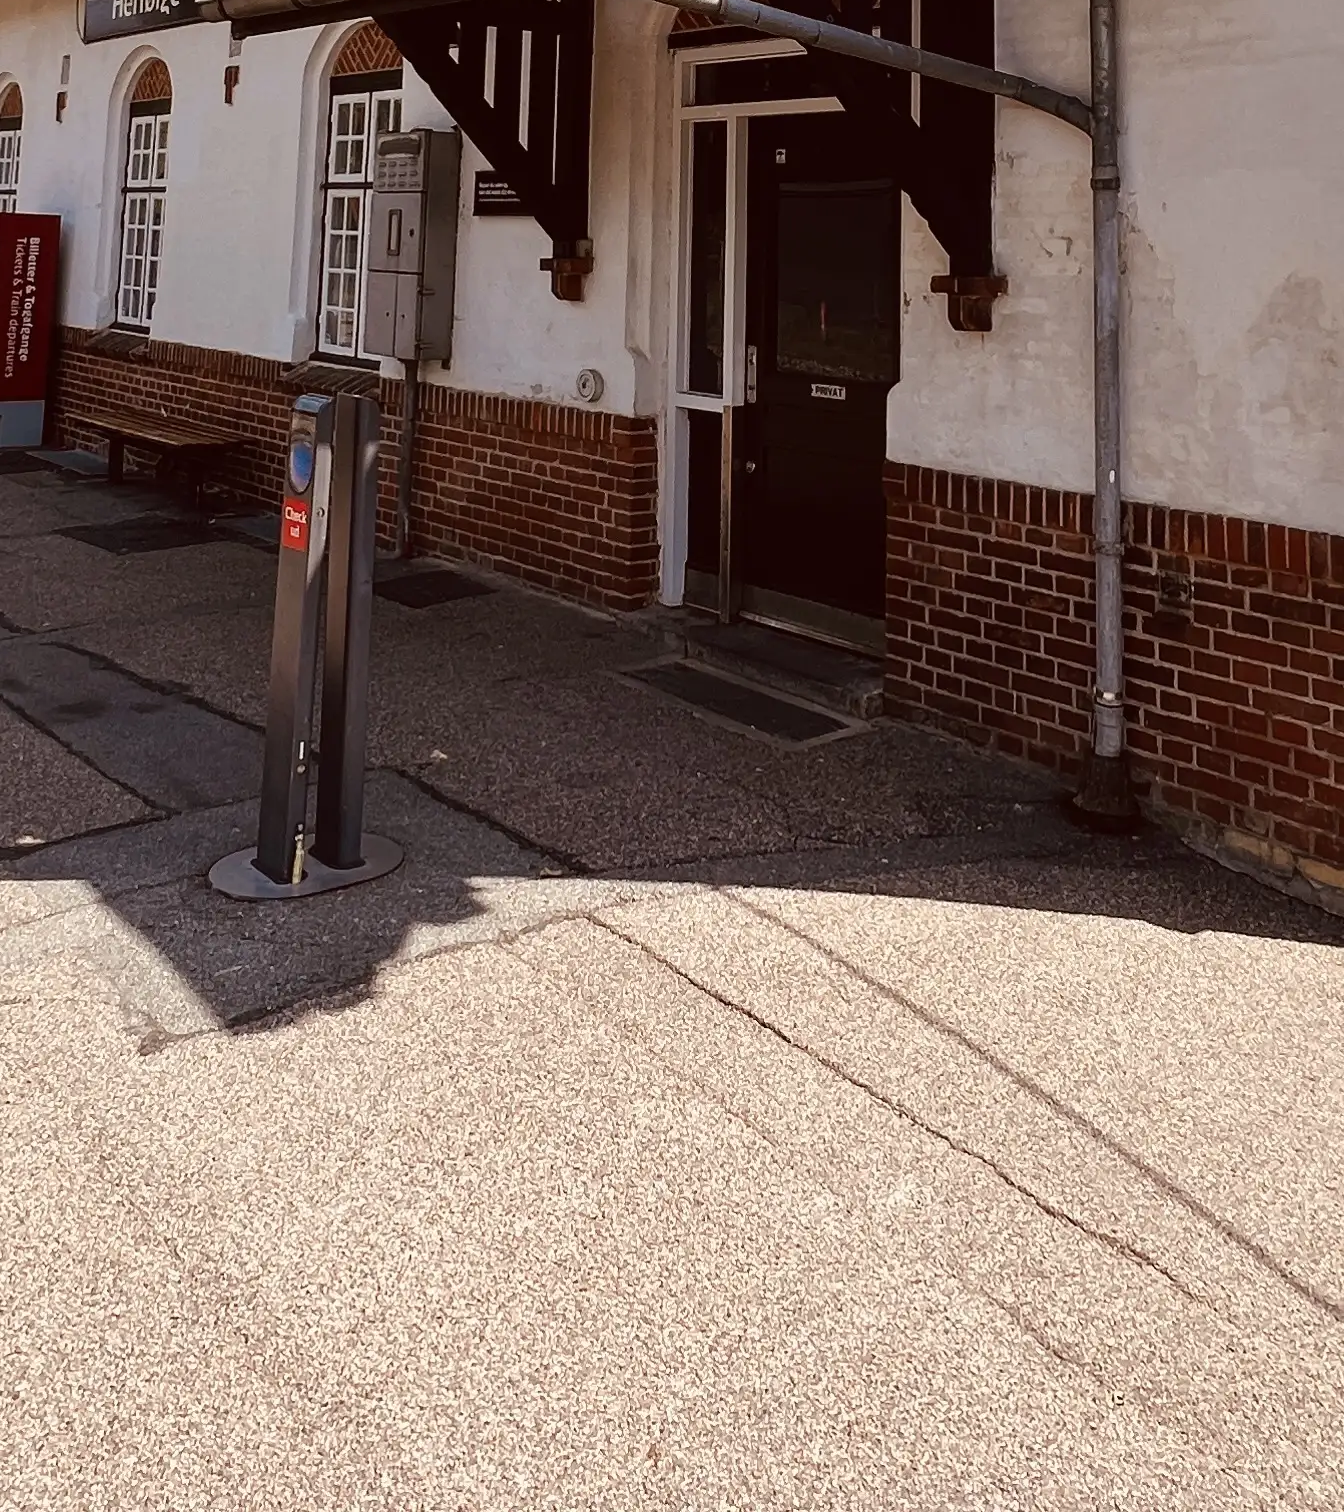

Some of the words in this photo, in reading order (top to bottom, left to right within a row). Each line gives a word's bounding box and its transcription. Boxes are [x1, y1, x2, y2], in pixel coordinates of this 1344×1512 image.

[13, 236, 28, 276] Tickets
[26, 237, 41, 283] Billetter
[12, 278, 24, 287] &
[25, 285, 36, 295] &
[10, 289, 23, 316] Train
[4, 319, 20, 378] departures
[815, 385, 843, 398] PRIVAT
[285, 506, 307, 524] Check
